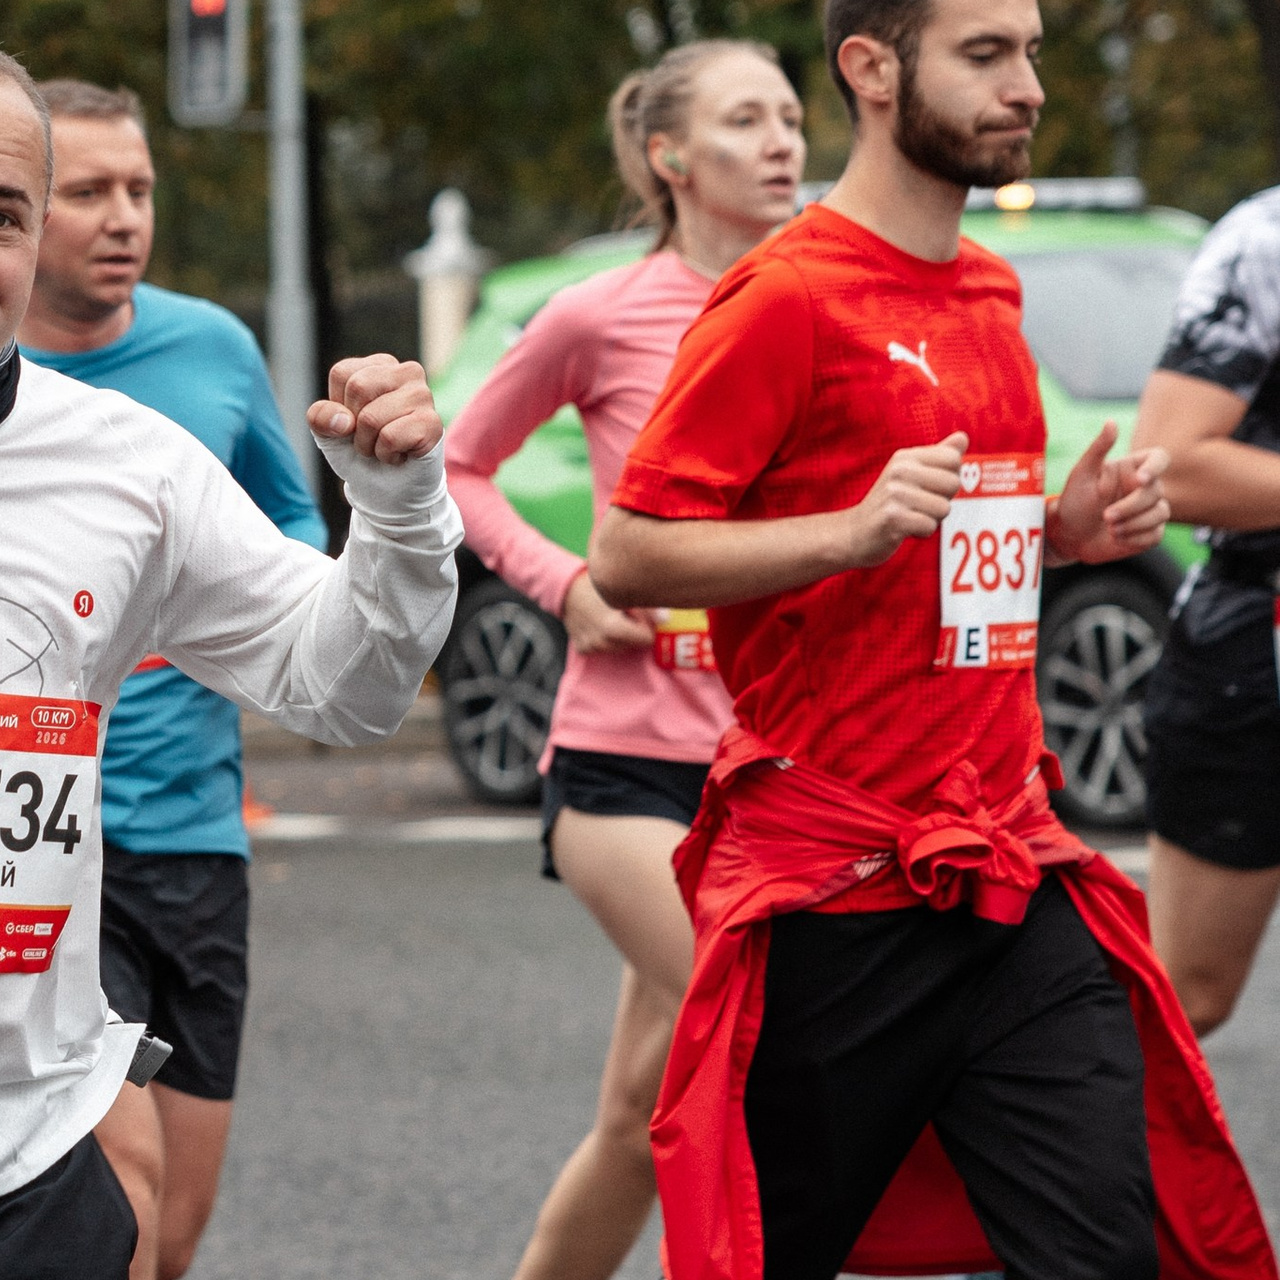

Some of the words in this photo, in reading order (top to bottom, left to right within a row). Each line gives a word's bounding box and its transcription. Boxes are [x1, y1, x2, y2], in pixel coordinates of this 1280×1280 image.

[965, 627, 981, 661] E
[674, 634, 699, 669] E
[37, 710, 49, 723] 10
[36, 731, 66, 745] 2026
[15, 925, 34, 933] СБЕР
